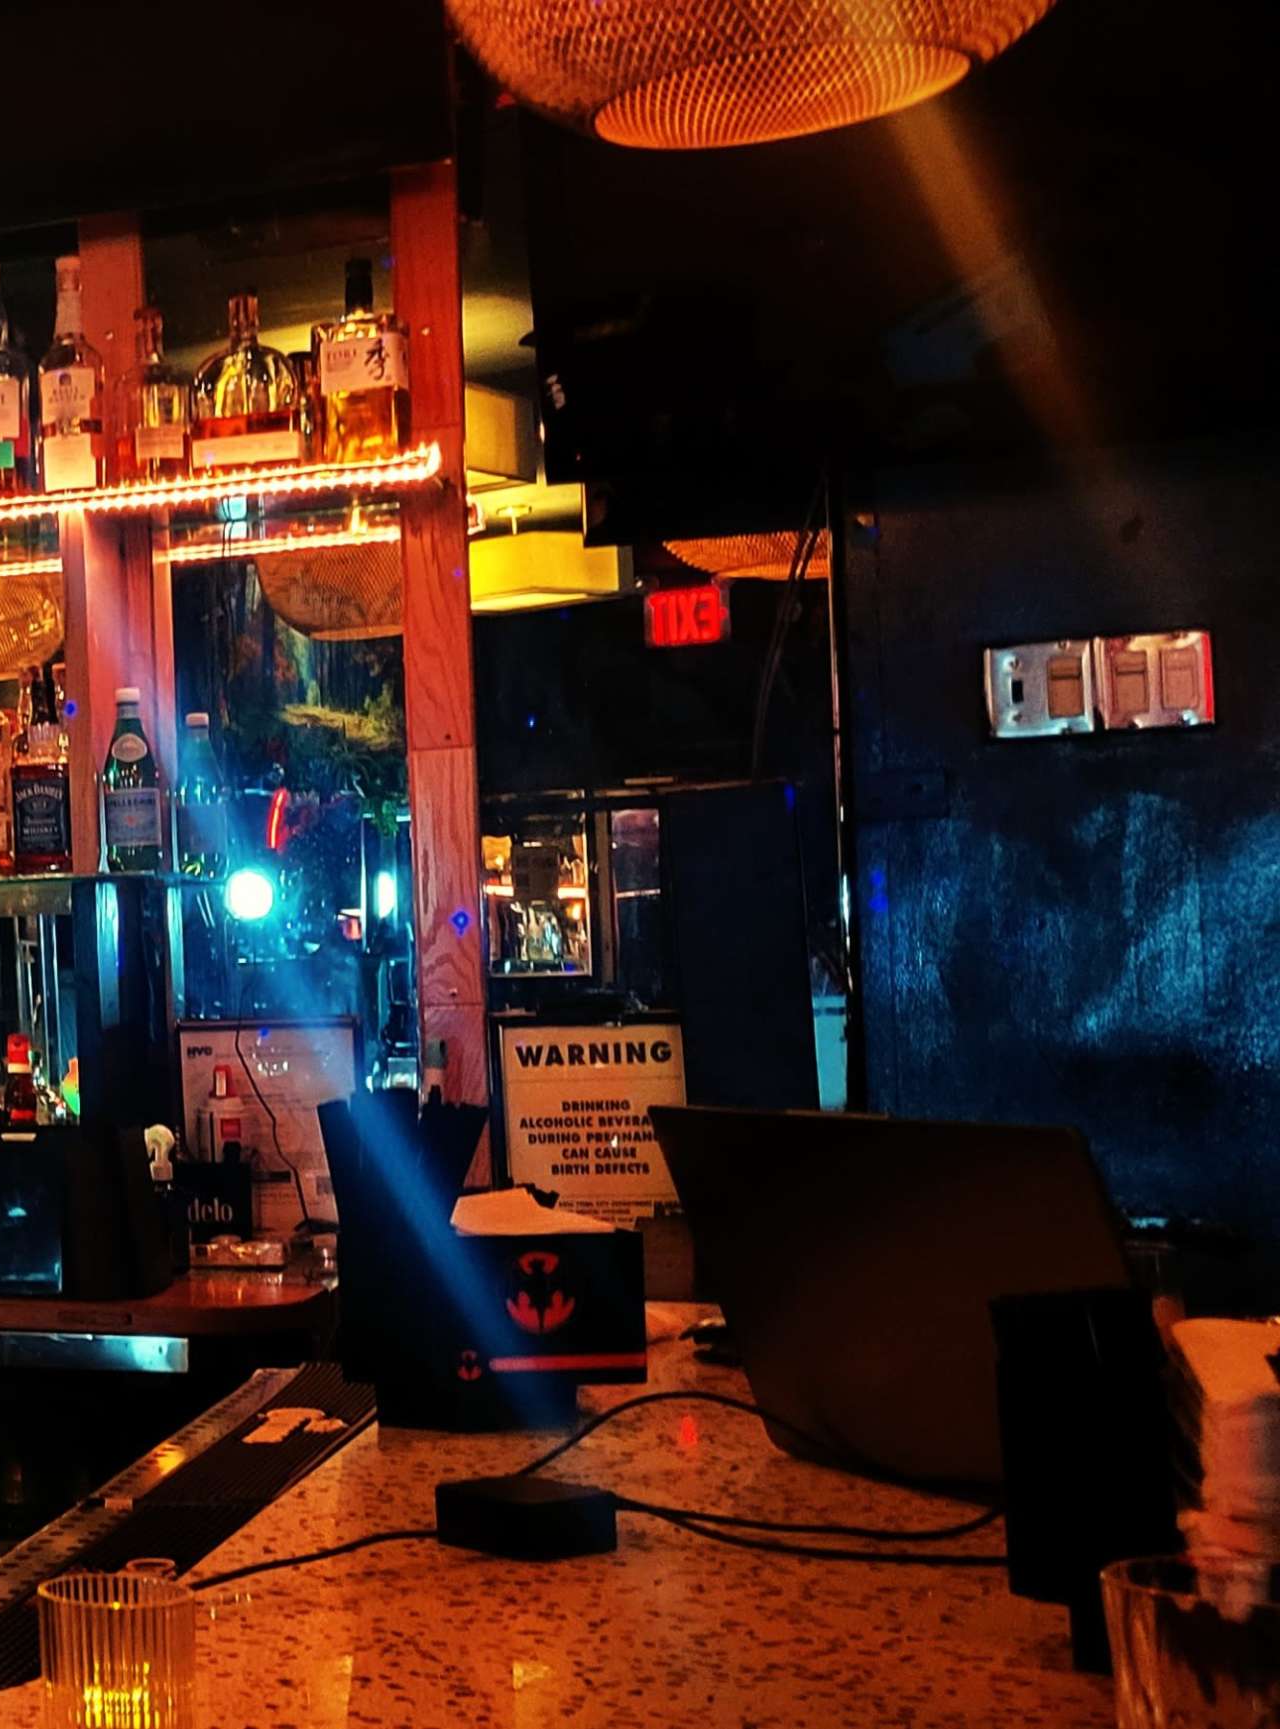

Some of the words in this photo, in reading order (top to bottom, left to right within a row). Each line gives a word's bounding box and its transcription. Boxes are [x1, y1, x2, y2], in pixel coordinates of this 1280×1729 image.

[515, 1041, 672, 1068] WARNING
[561, 1099, 631, 1112] DRINKING
[519, 1115, 593, 1129] ALCOHOLIC
[598, 1115, 651, 1127] BEVERA
[528, 1132, 581, 1145] DURING
[562, 1148, 589, 1160] CAN
[594, 1147, 637, 1159] CAUSE
[551, 1163, 590, 1176] BIRTH
[595, 1162, 650, 1175] DEFECTS
